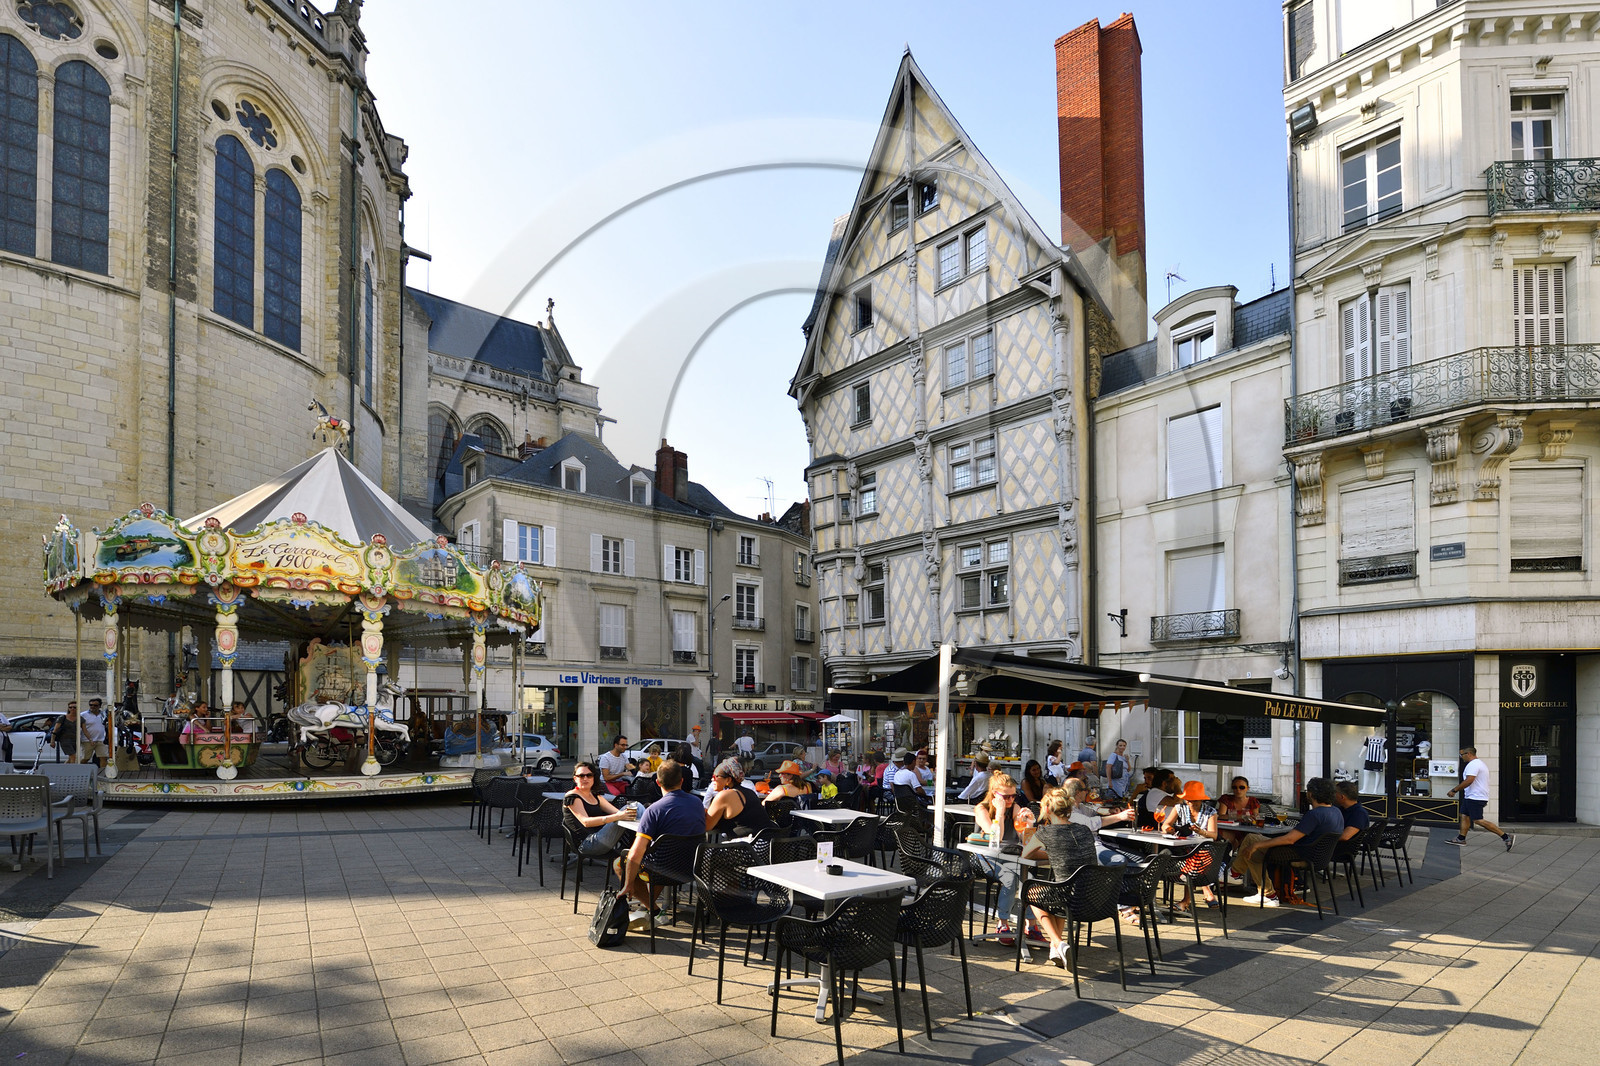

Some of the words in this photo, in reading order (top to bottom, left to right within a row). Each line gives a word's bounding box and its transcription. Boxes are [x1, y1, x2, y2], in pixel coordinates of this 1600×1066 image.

[242, 546, 269, 558] Le
[269, 543, 347, 567] Carrousel
[274, 554, 312, 569] 1900
[559, 674, 578, 683] Les
[581, 672, 621, 685] Vitrines
[624, 676, 663, 687] d'Angers
[1264, 700, 1281, 716] Pub
[1283, 703, 1296, 718] LE
[1297, 704, 1322, 720] KENT
